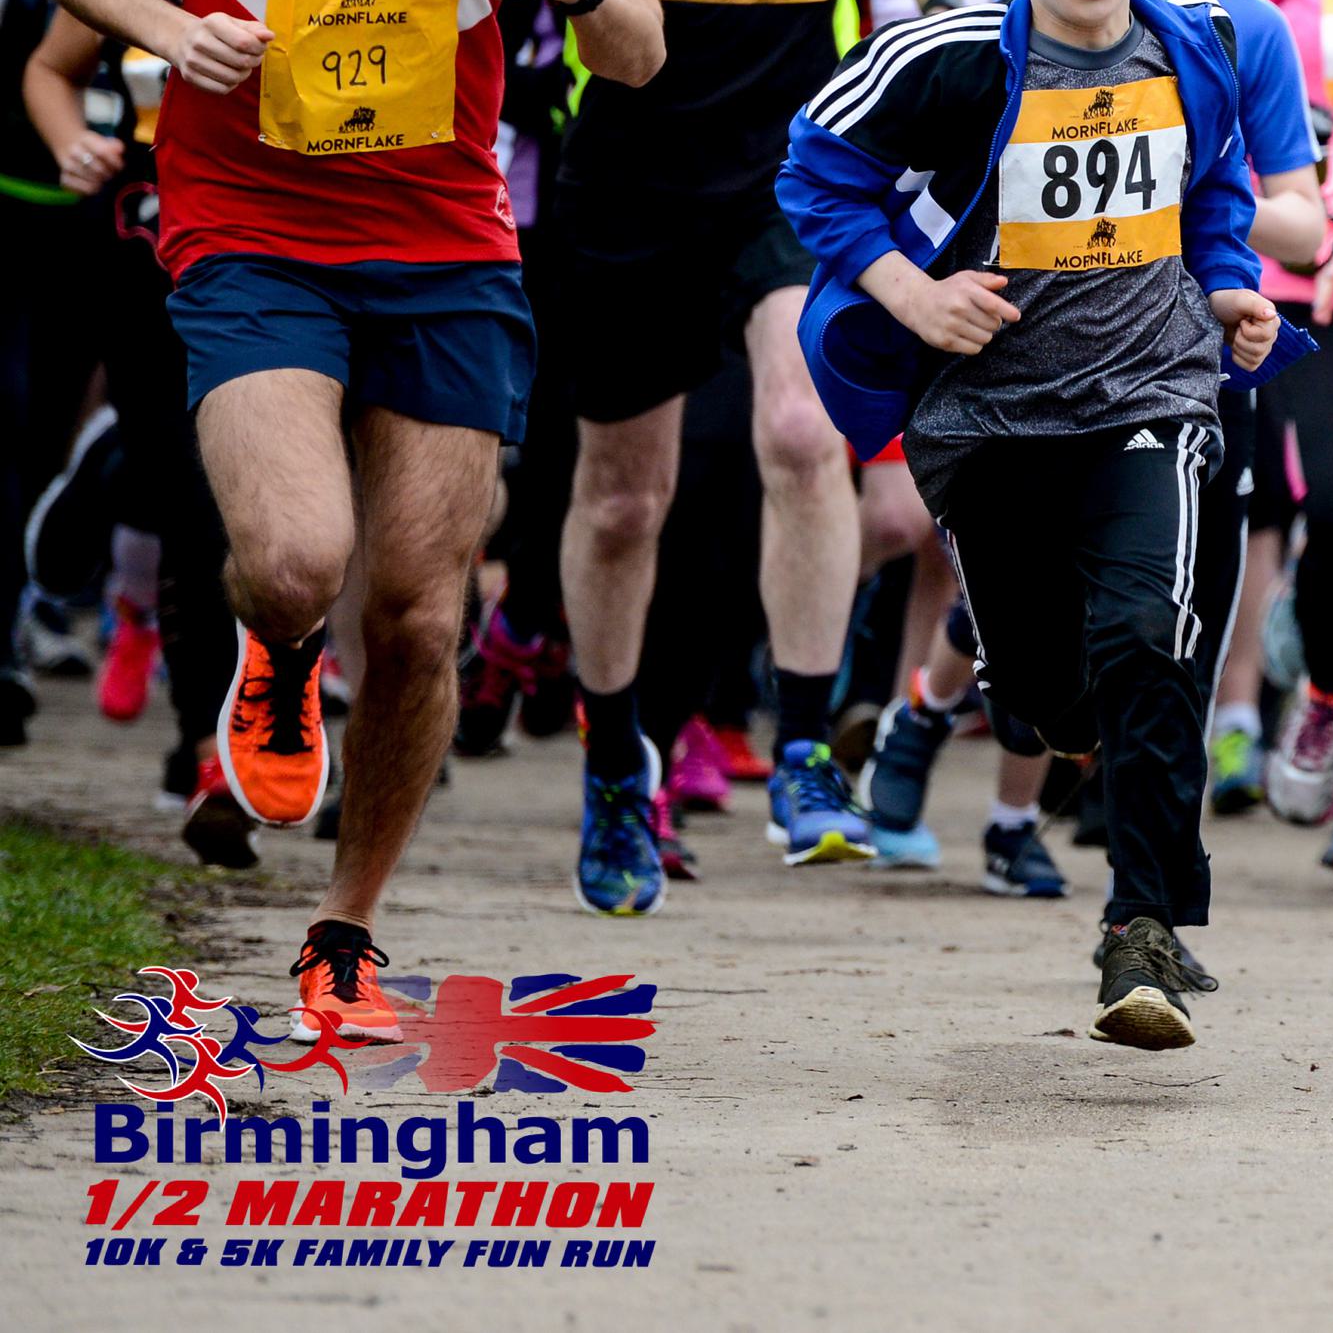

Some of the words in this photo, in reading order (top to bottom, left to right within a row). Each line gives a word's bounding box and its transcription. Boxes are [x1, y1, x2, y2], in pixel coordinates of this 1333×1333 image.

[307, 11, 408, 27] MORNFLAKE
[321, 44, 387, 91] 929
[1051, 117, 1139, 140] MORNFLAKE
[306, 133, 405, 153] MORNFLAKE
[1041, 134, 1157, 219] 894
[1054, 249, 1143, 269] MORNFLAKE
